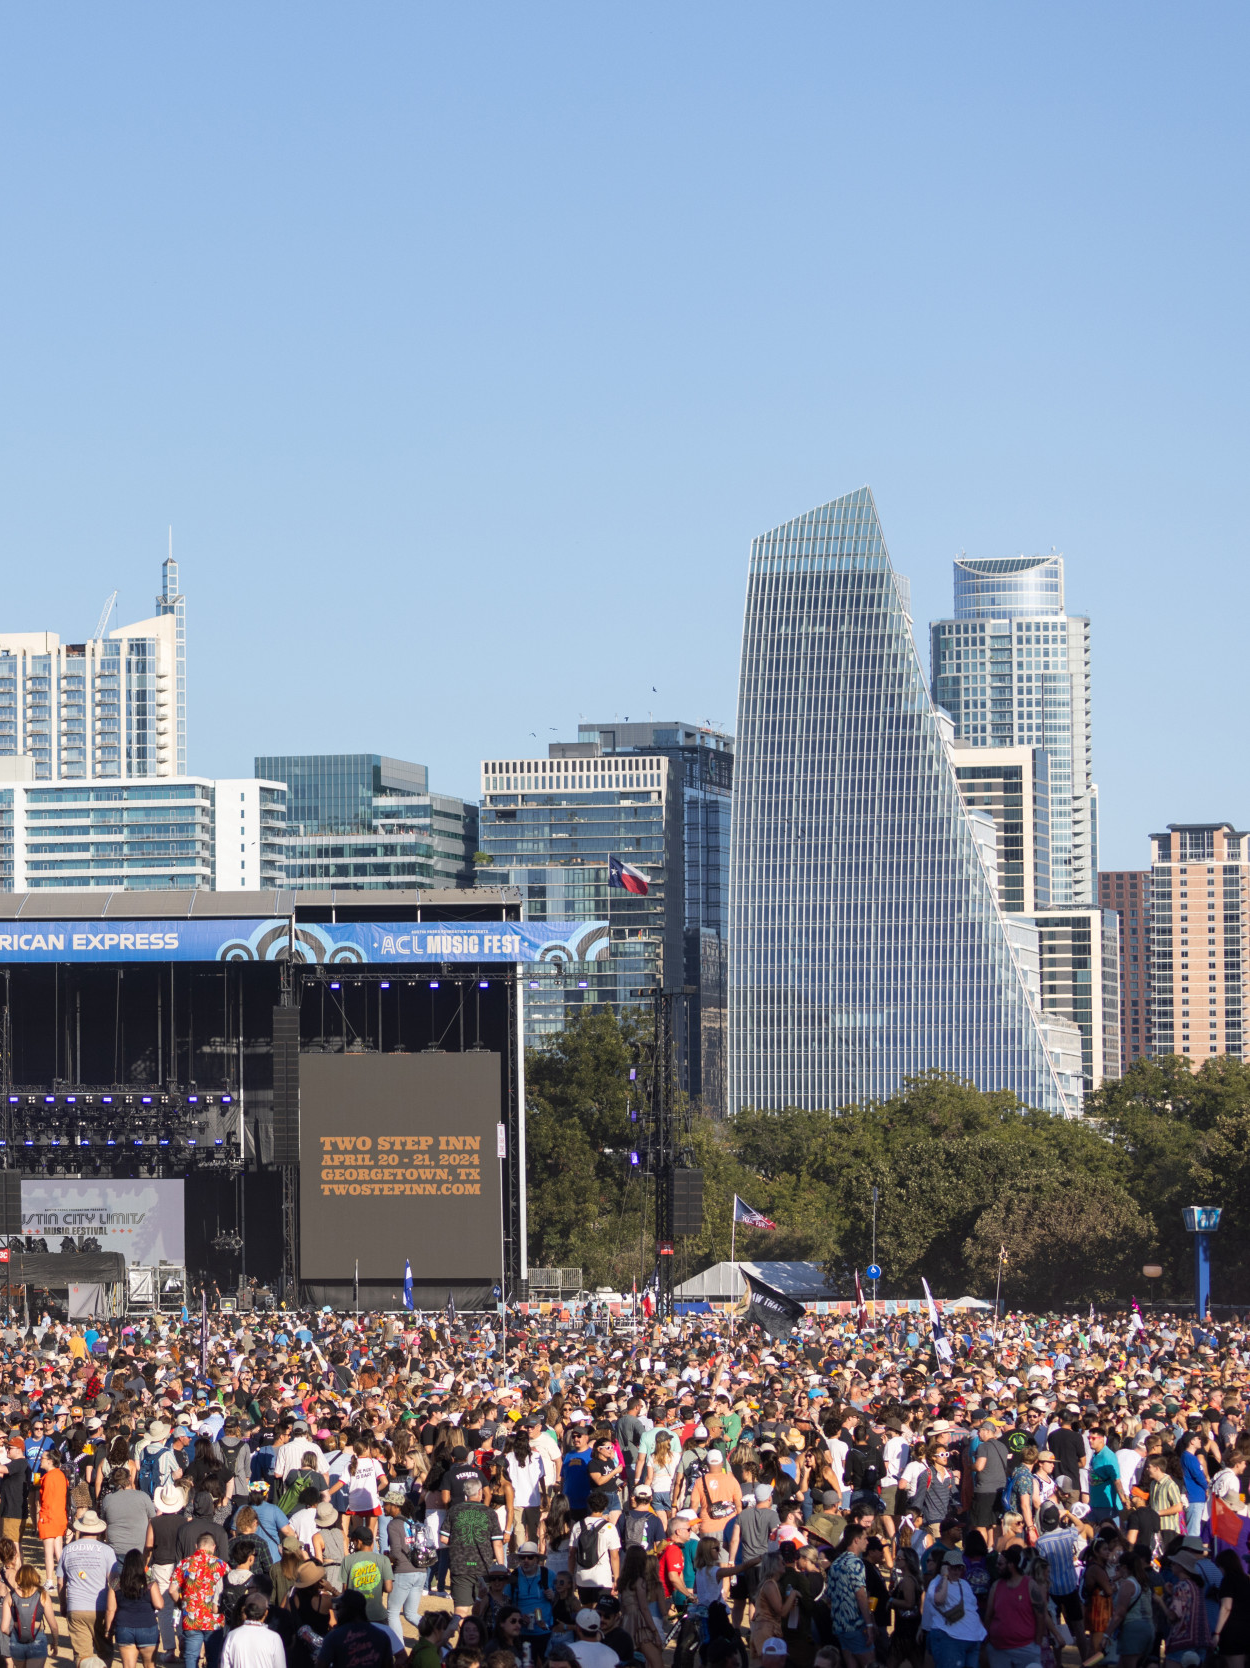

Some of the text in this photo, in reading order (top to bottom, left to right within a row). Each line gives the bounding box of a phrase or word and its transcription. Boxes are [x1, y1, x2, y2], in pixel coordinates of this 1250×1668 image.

[72, 933, 179, 950] EXPRESS
[381, 935, 521, 955] ACL MUSIC FEST
[320, 1137, 372, 1151] TWO
[378, 1136, 434, 1151] STEP
[438, 1136, 482, 1150] INN
[321, 1154, 374, 1166] APRIL
[378, 1154, 399, 1166] 20
[413, 1154, 435, 1167] 21,
[439, 1154, 480, 1166] 2024
[321, 1168, 481, 1182] GEORGETOWN, TX
[320, 1183, 482, 1196] TWOSTEPINN.COM
[21, 1212, 146, 1225] STIN CITY LIMITS
[44, 1227, 108, 1236] MUSIC FESTIVAL
[0, 1251, 8, 1259] 3C
[352, 1563, 377, 1579] SANTA
[354, 1574, 378, 1588] CRUZ
